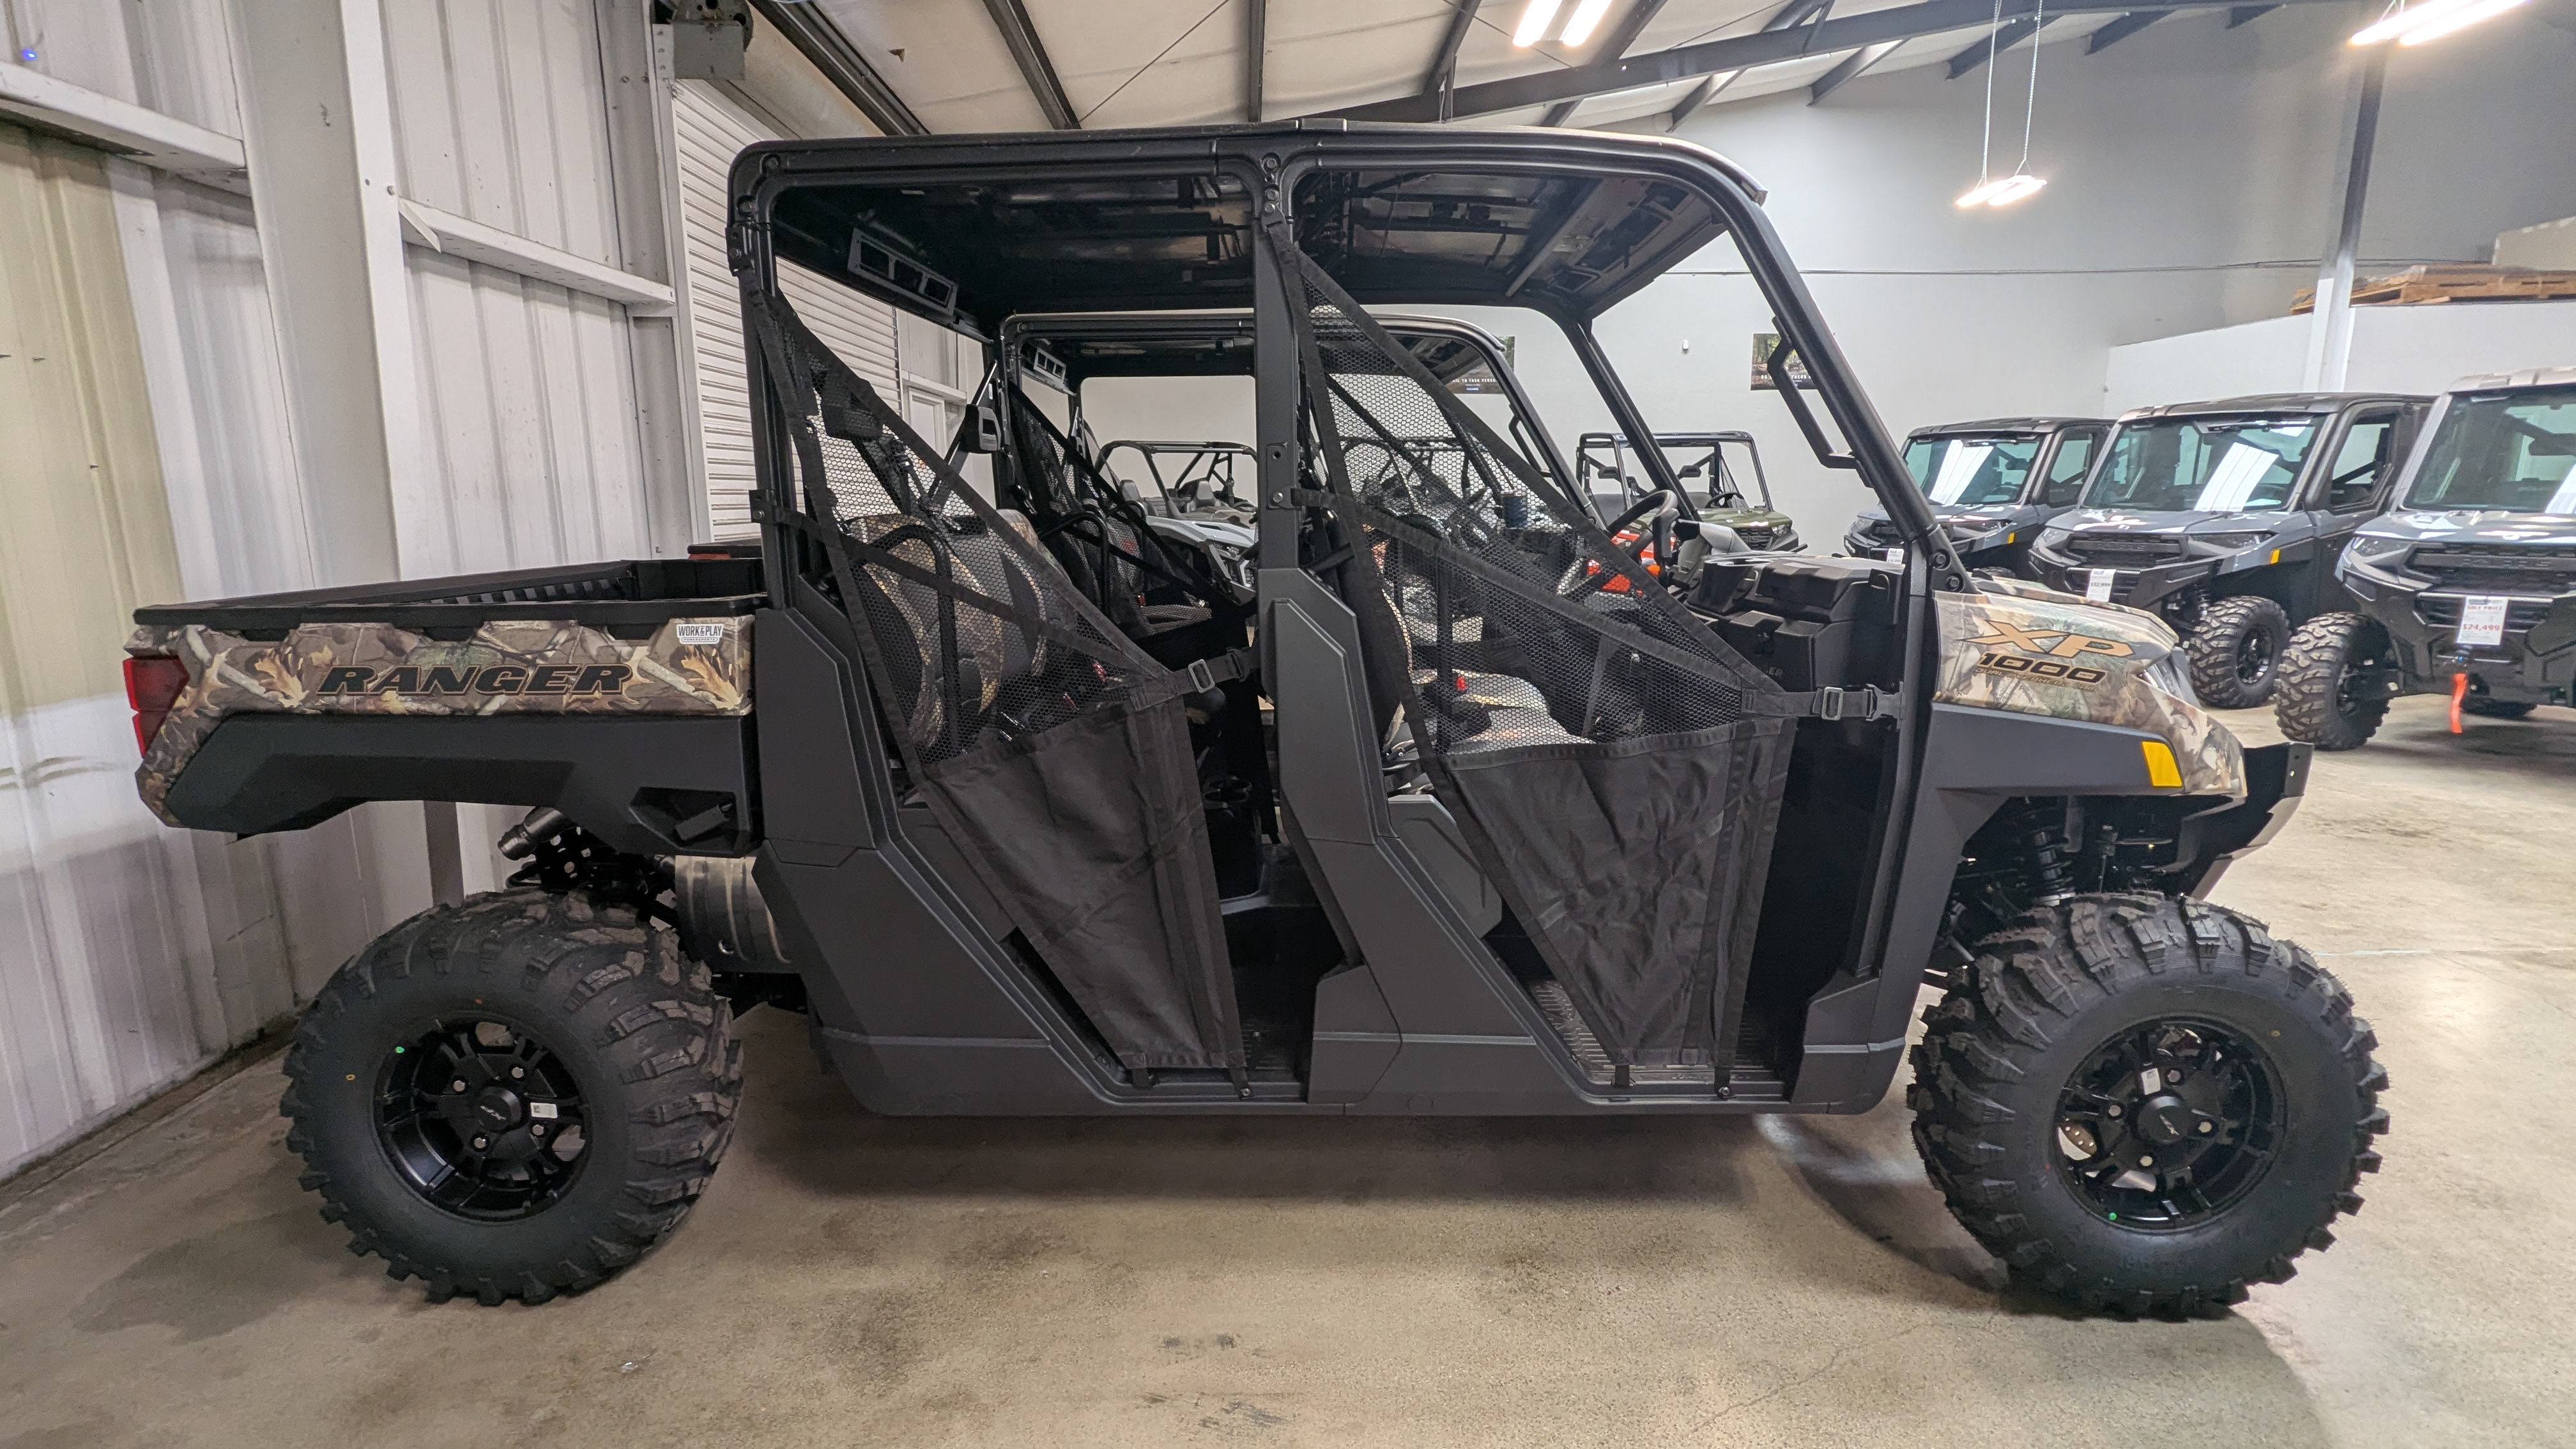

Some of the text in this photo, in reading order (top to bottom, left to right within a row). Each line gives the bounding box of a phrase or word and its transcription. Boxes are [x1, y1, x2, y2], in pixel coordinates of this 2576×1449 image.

[1961, 619, 2135, 659] XP
[317, 663, 633, 696] RANGER
[1977, 651, 2108, 684] 1000
